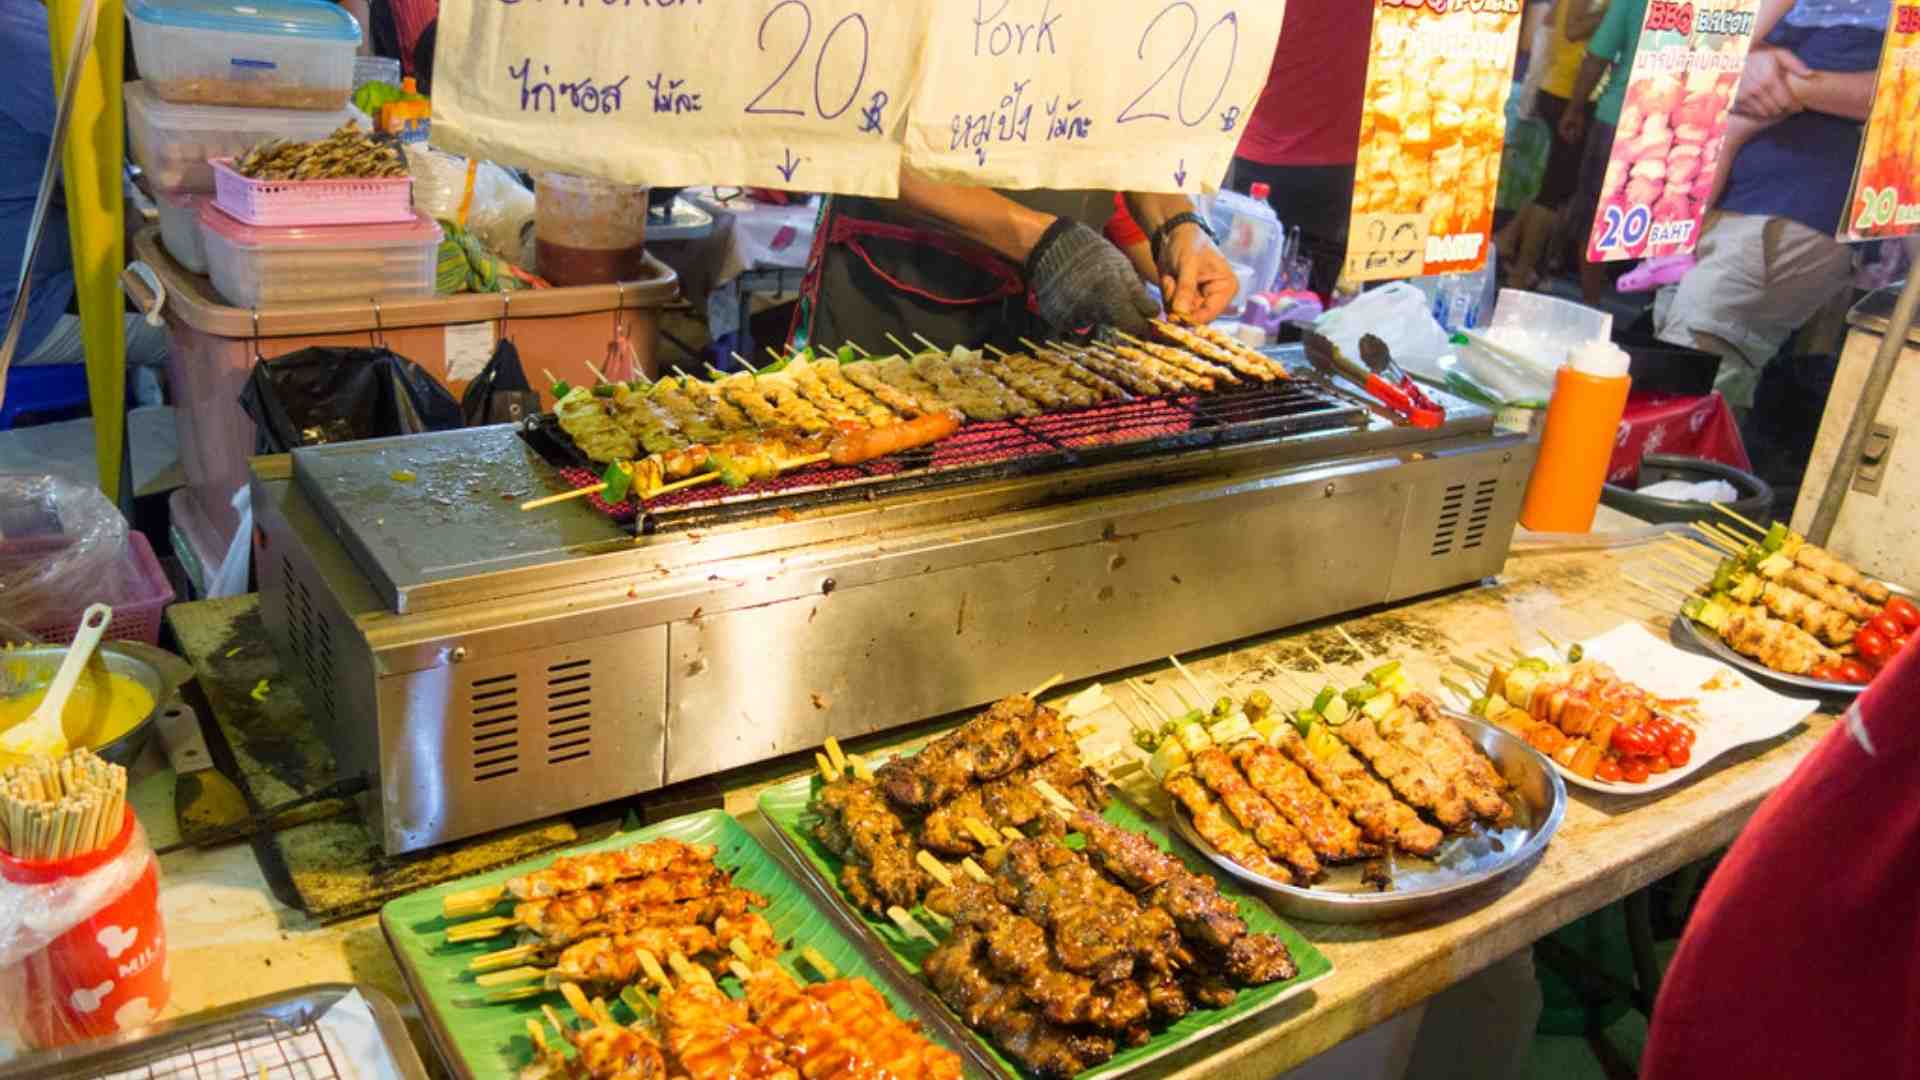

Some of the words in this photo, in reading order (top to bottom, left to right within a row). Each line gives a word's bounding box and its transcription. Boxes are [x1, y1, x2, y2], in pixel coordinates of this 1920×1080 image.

[973, 0, 1062, 56] Pork
[1646, 1, 1692, 36] BBQ
[1697, 8, 1754, 36] BACON
[508, 58, 630, 114] ไก่ซอส
[745, 0, 868, 119] 20
[950, 79, 1032, 166] หมูปิ้ง
[1117, 1, 1238, 126] 20
[1596, 203, 1650, 250] 20
[1648, 220, 1695, 244] BAHT
[1856, 186, 1898, 228] 20
